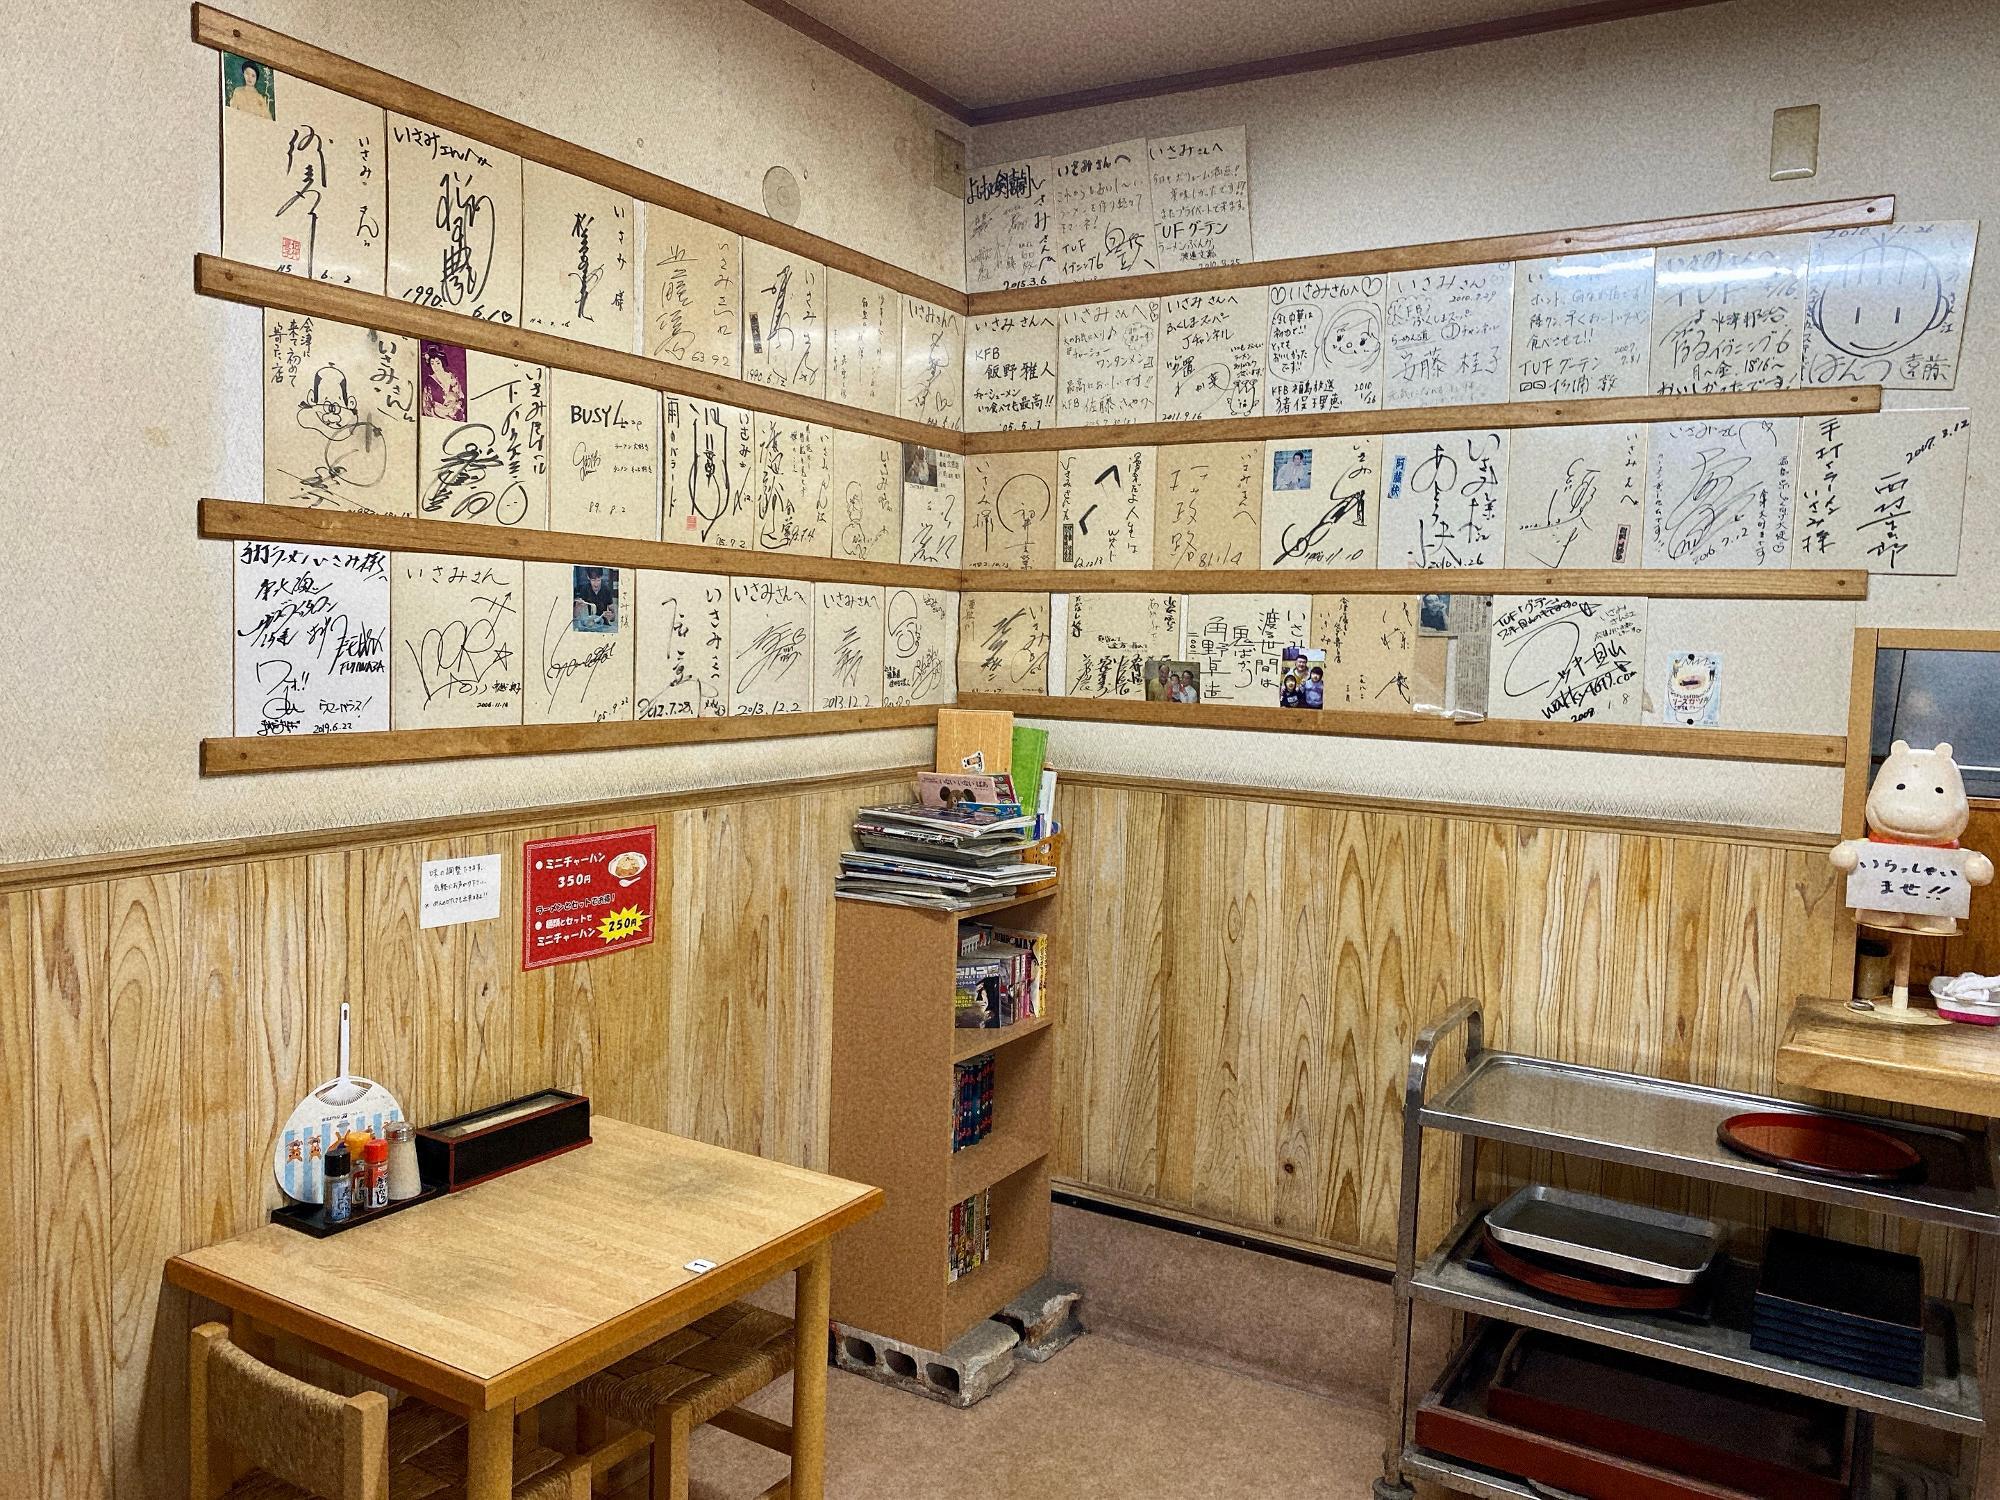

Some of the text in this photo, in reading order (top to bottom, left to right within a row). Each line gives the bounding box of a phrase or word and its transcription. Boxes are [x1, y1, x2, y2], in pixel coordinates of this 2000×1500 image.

[974, 346, 1000, 361] KFB
[571, 404, 612, 427] BUSY
[545, 852, 606, 871] ミニチャーハン
[557, 874, 591, 889] 350円
[608, 916, 638, 933] 250円
[536, 926, 597, 947] ミニチャーハン
